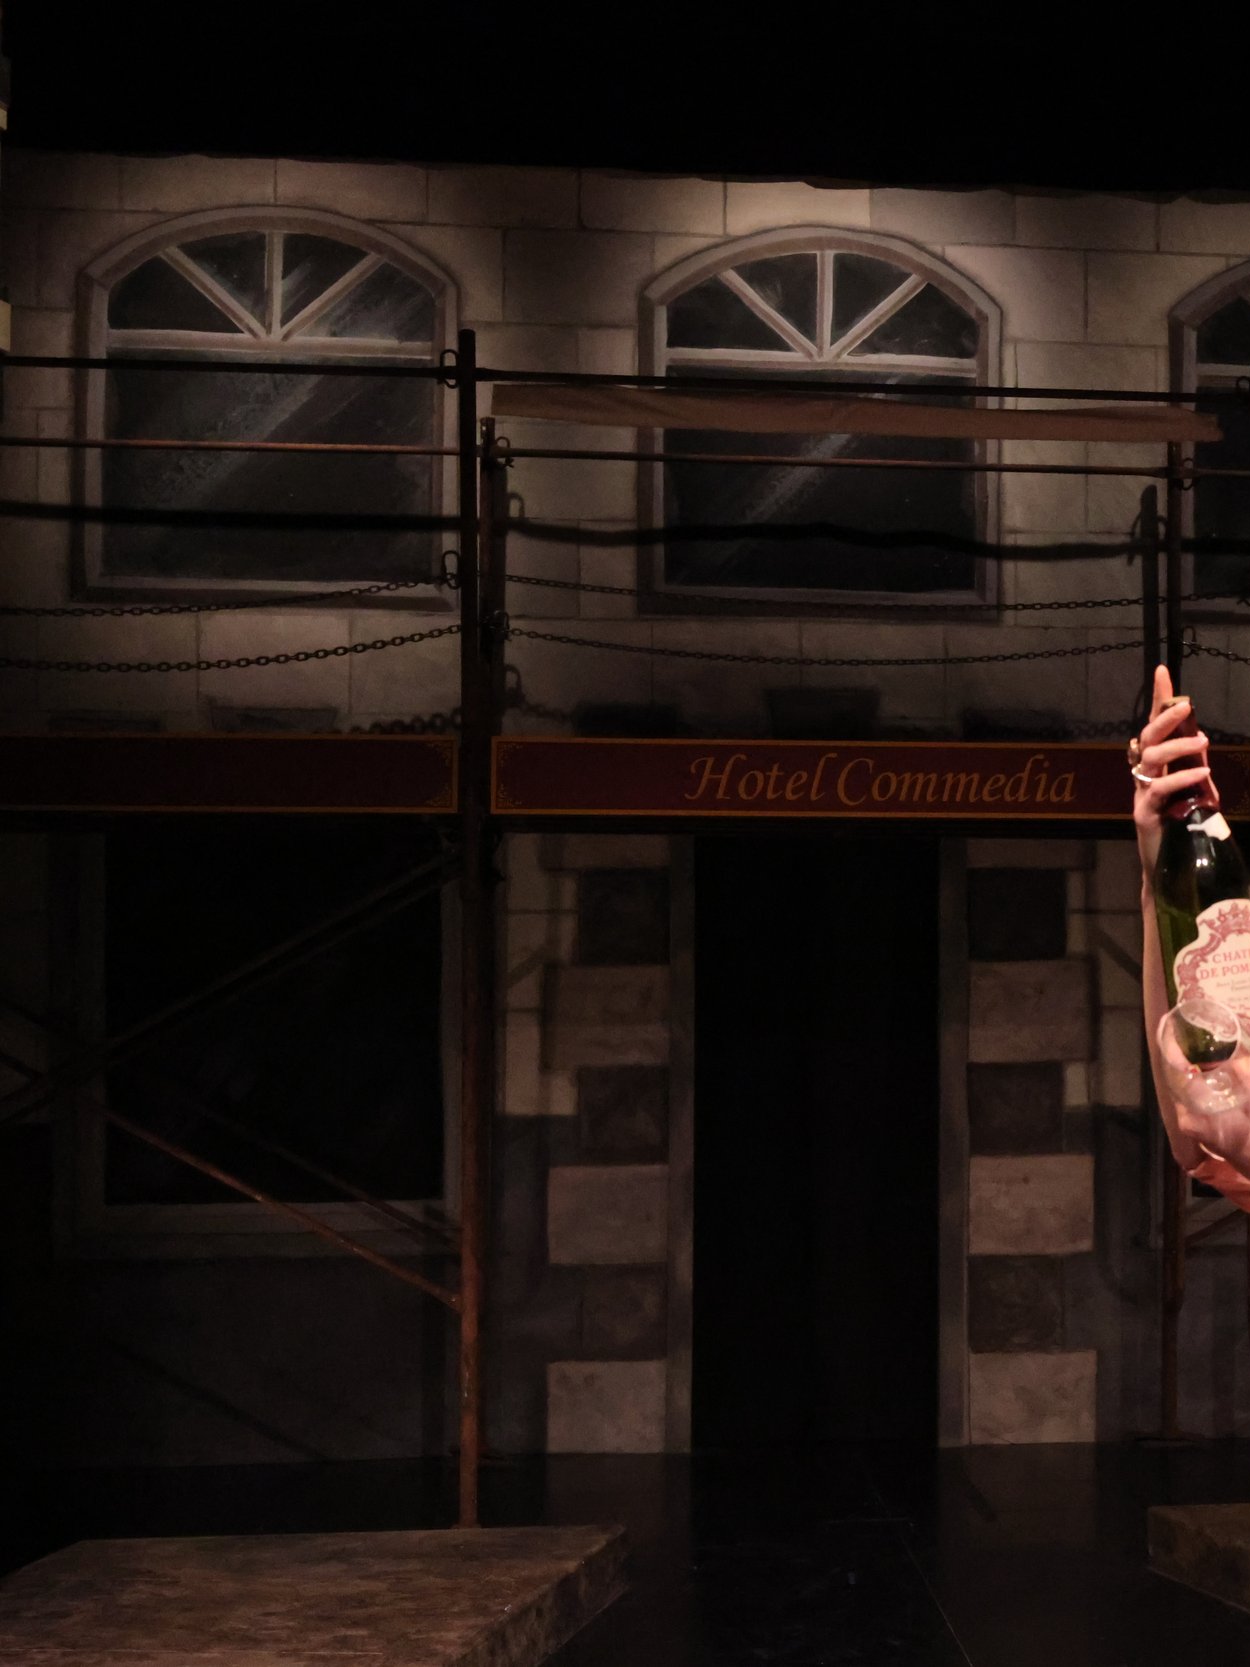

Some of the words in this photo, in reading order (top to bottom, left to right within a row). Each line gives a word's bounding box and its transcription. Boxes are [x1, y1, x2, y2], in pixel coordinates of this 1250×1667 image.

[684, 753, 838, 801] Hotel
[837, 754, 1077, 806] Commedia
[1200, 968, 1218, 979] DE
